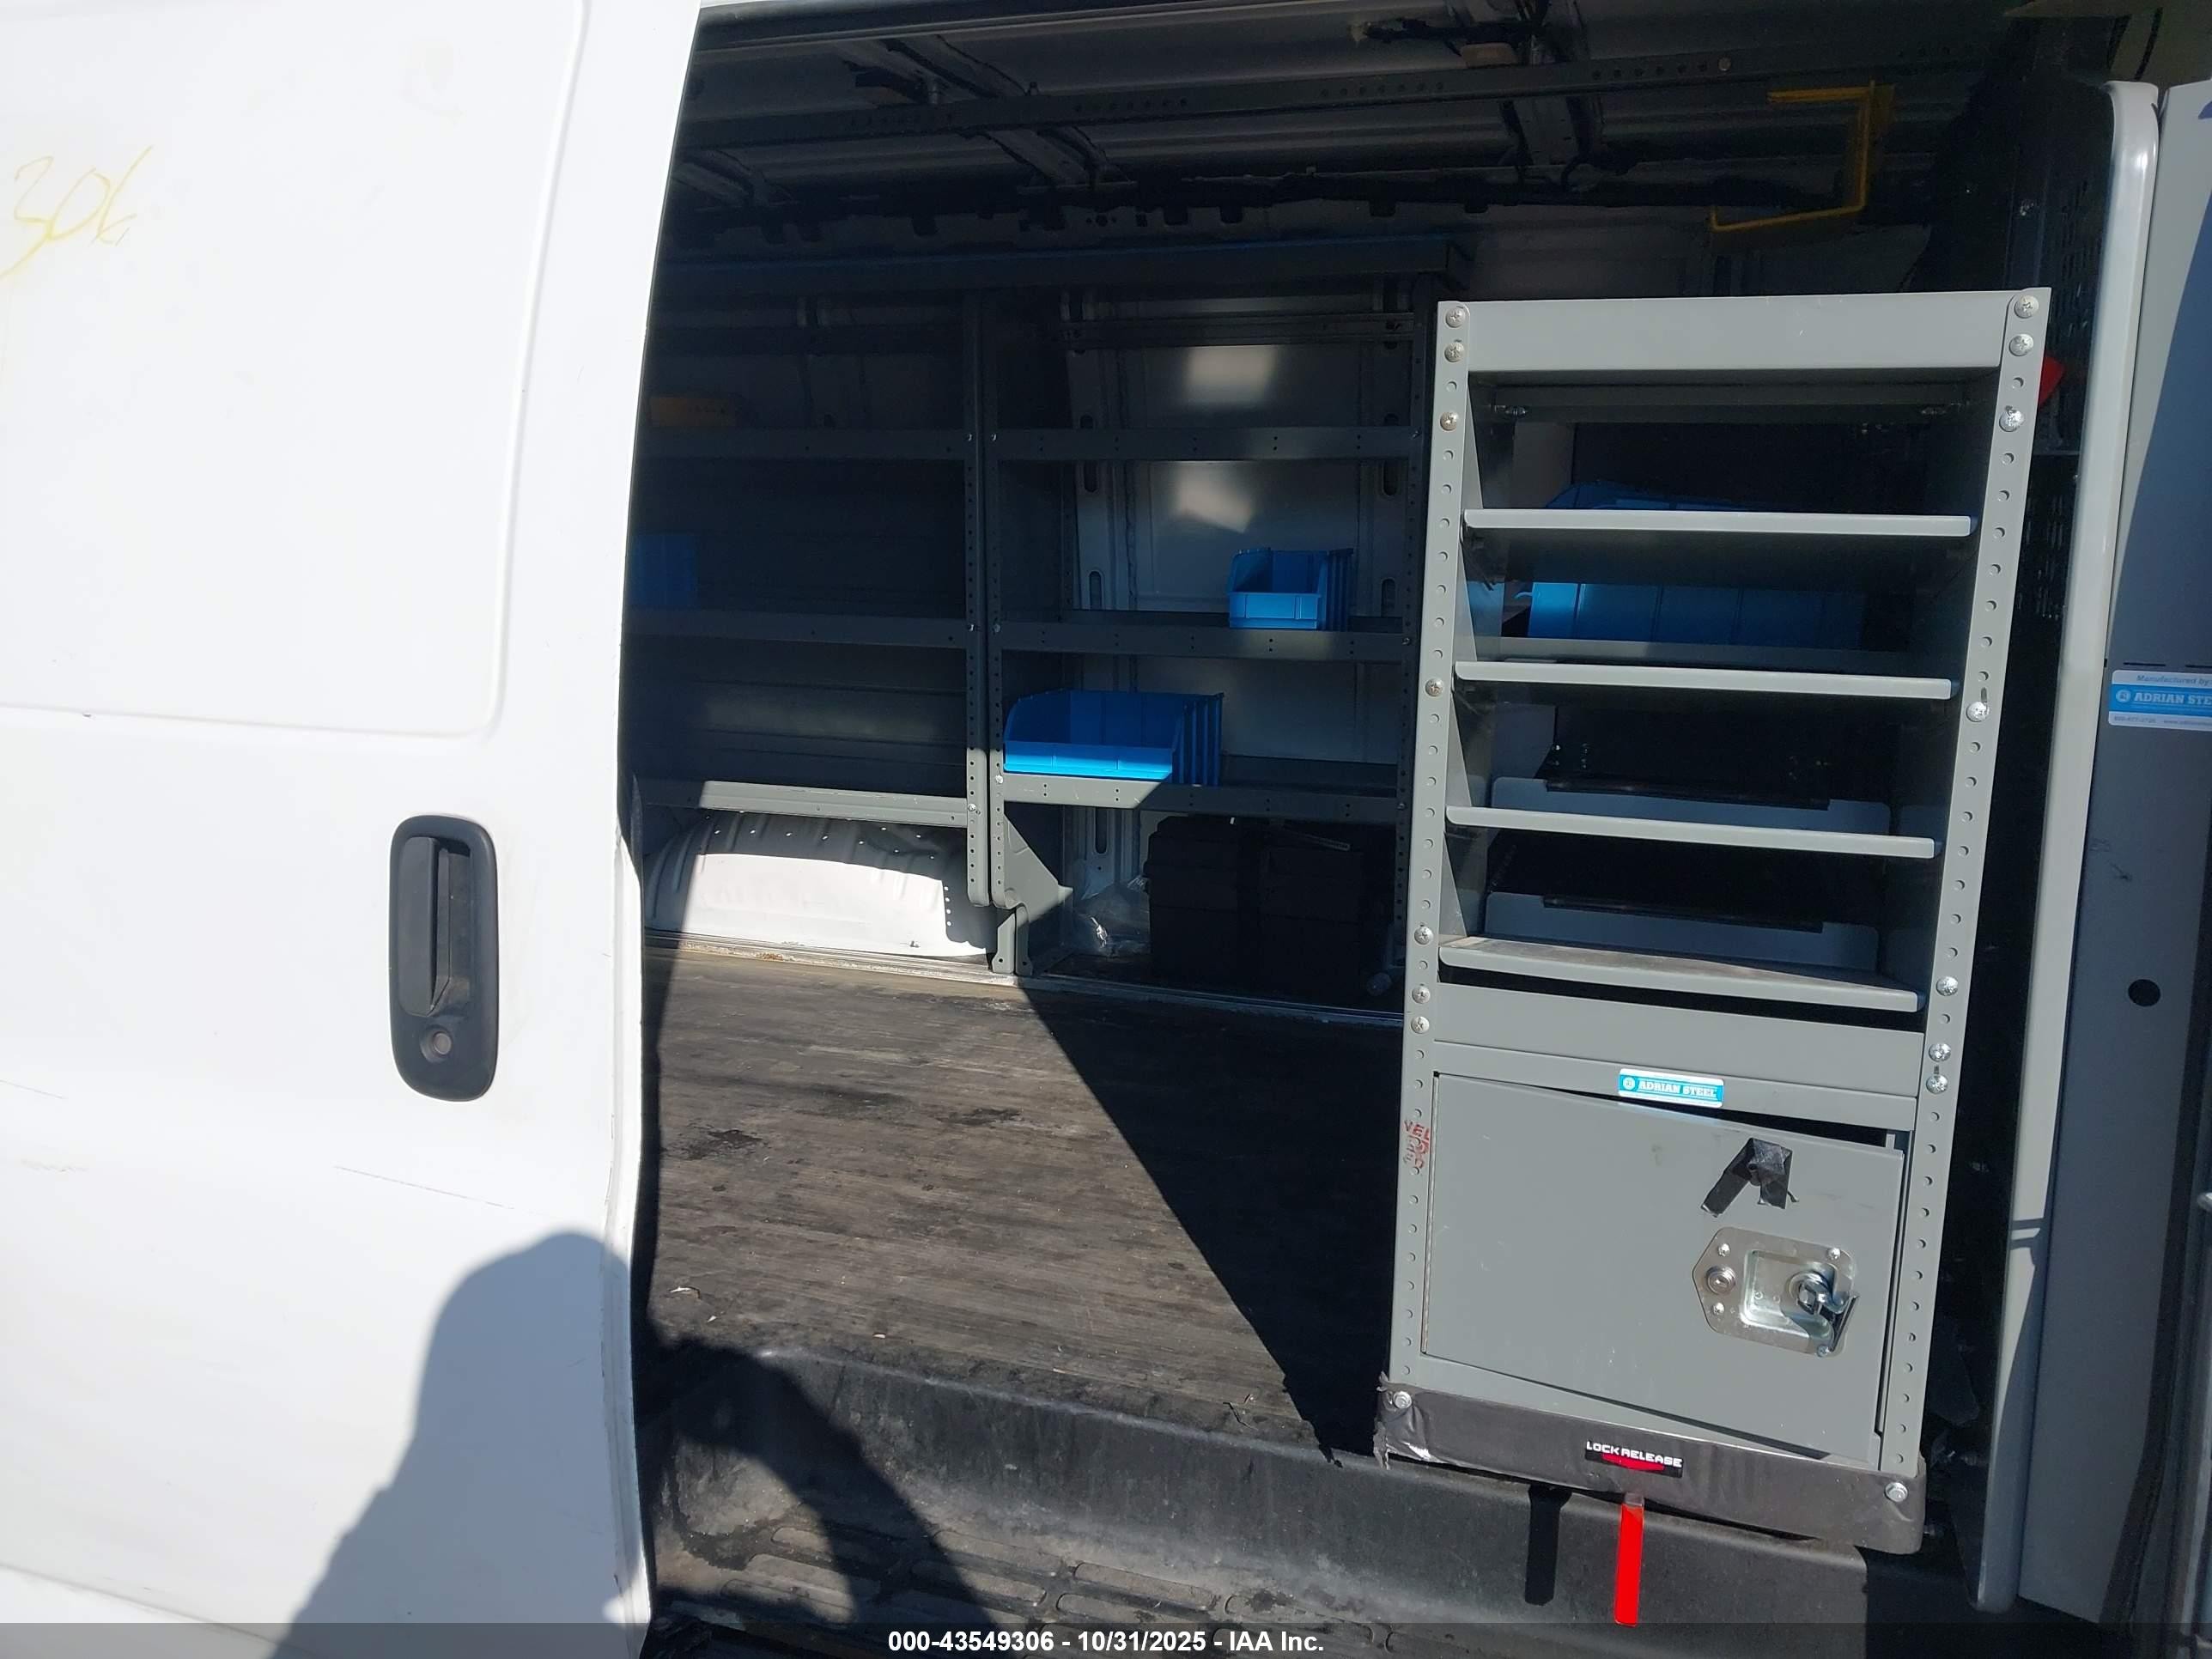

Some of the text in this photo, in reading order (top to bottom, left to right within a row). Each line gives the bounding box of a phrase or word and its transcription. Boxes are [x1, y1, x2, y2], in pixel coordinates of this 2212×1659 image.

[2134, 692, 2185, 703] ADRIAN
[1638, 1079, 1717, 1098] ADRIAN STEEL
[1586, 1441, 1683, 1468] LOCK RELEASE
